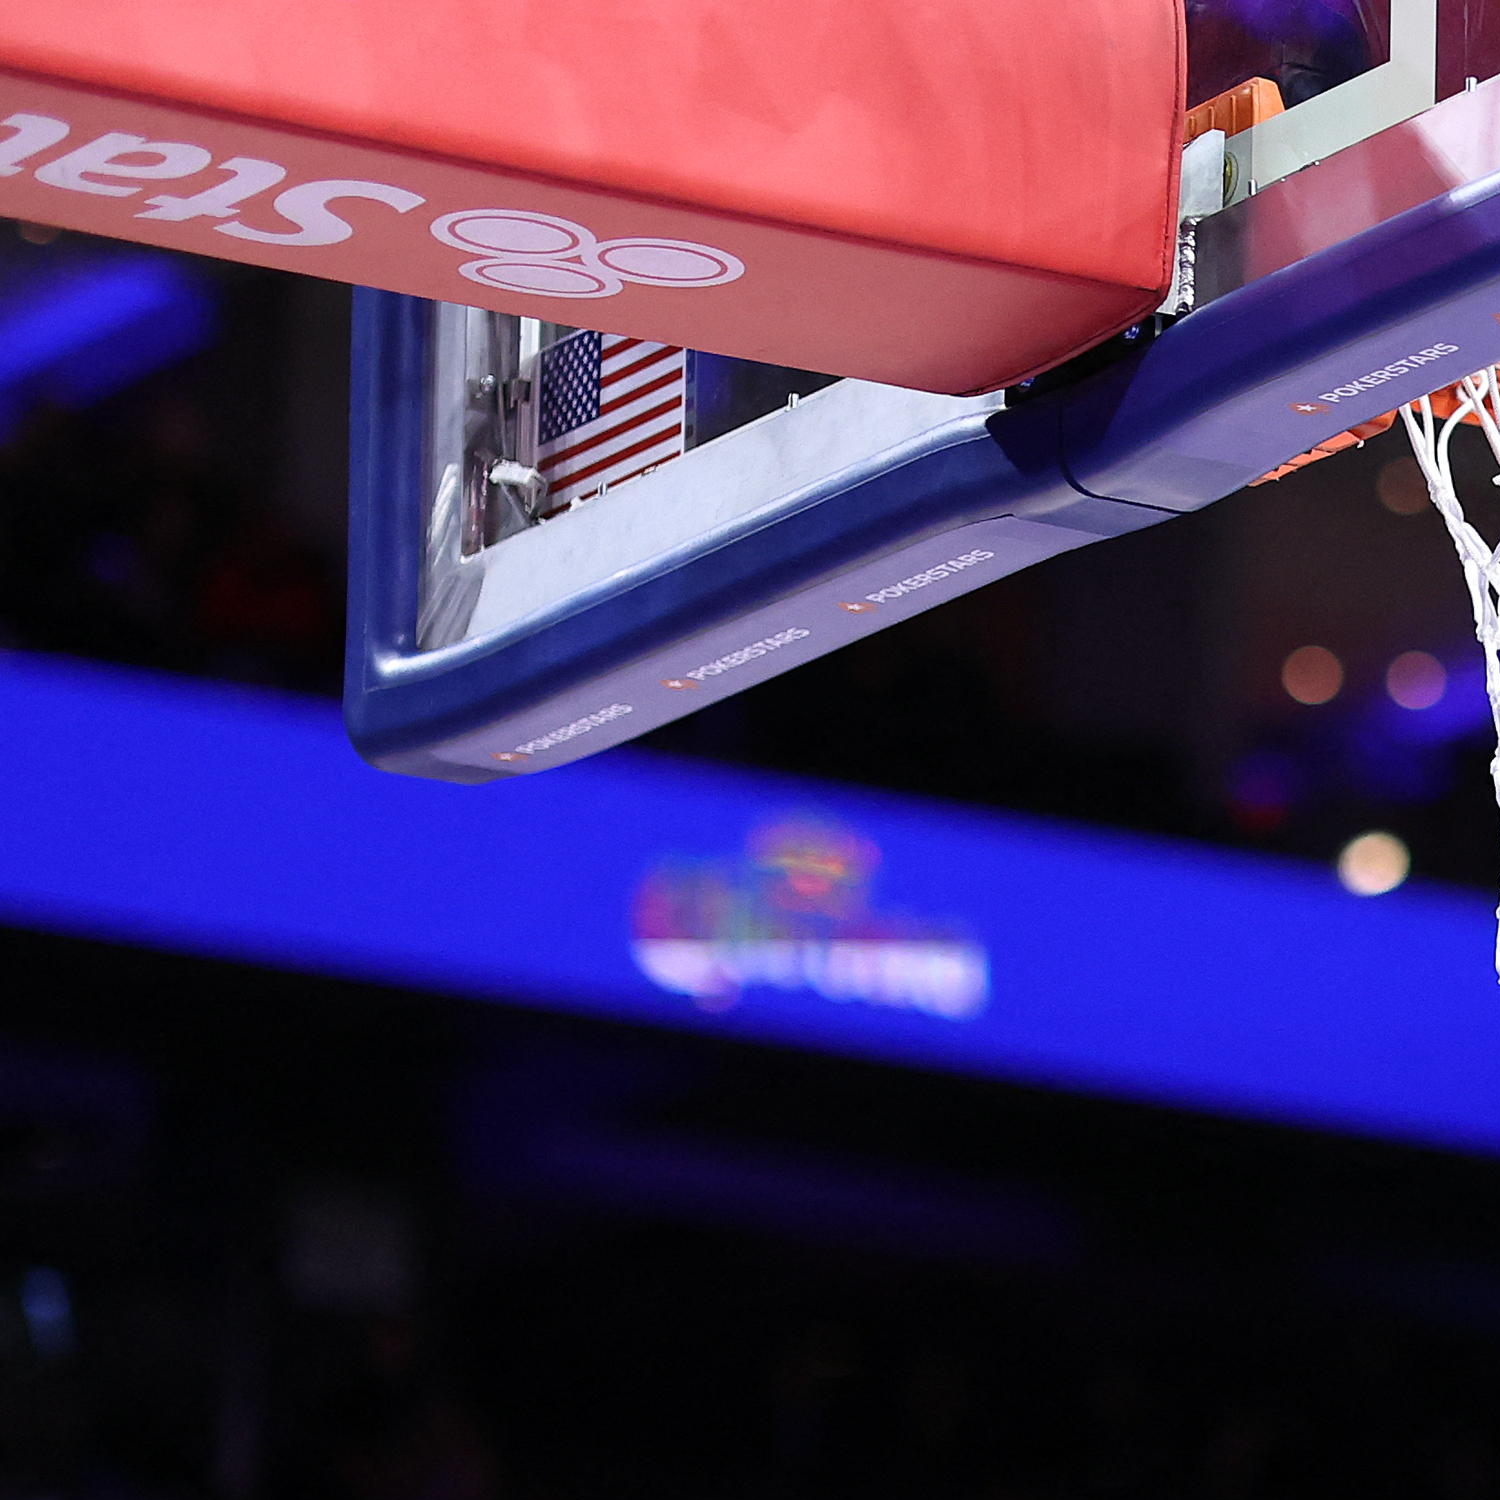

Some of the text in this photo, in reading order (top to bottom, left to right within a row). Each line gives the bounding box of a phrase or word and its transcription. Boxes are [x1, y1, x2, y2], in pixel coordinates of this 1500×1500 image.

[1318, 342, 1460, 403] POKERSTARS
[865, 549, 995, 604] POKERSTARS
[686, 627, 811, 680] POKERSTARS
[514, 703, 633, 755] POKERSTARS
